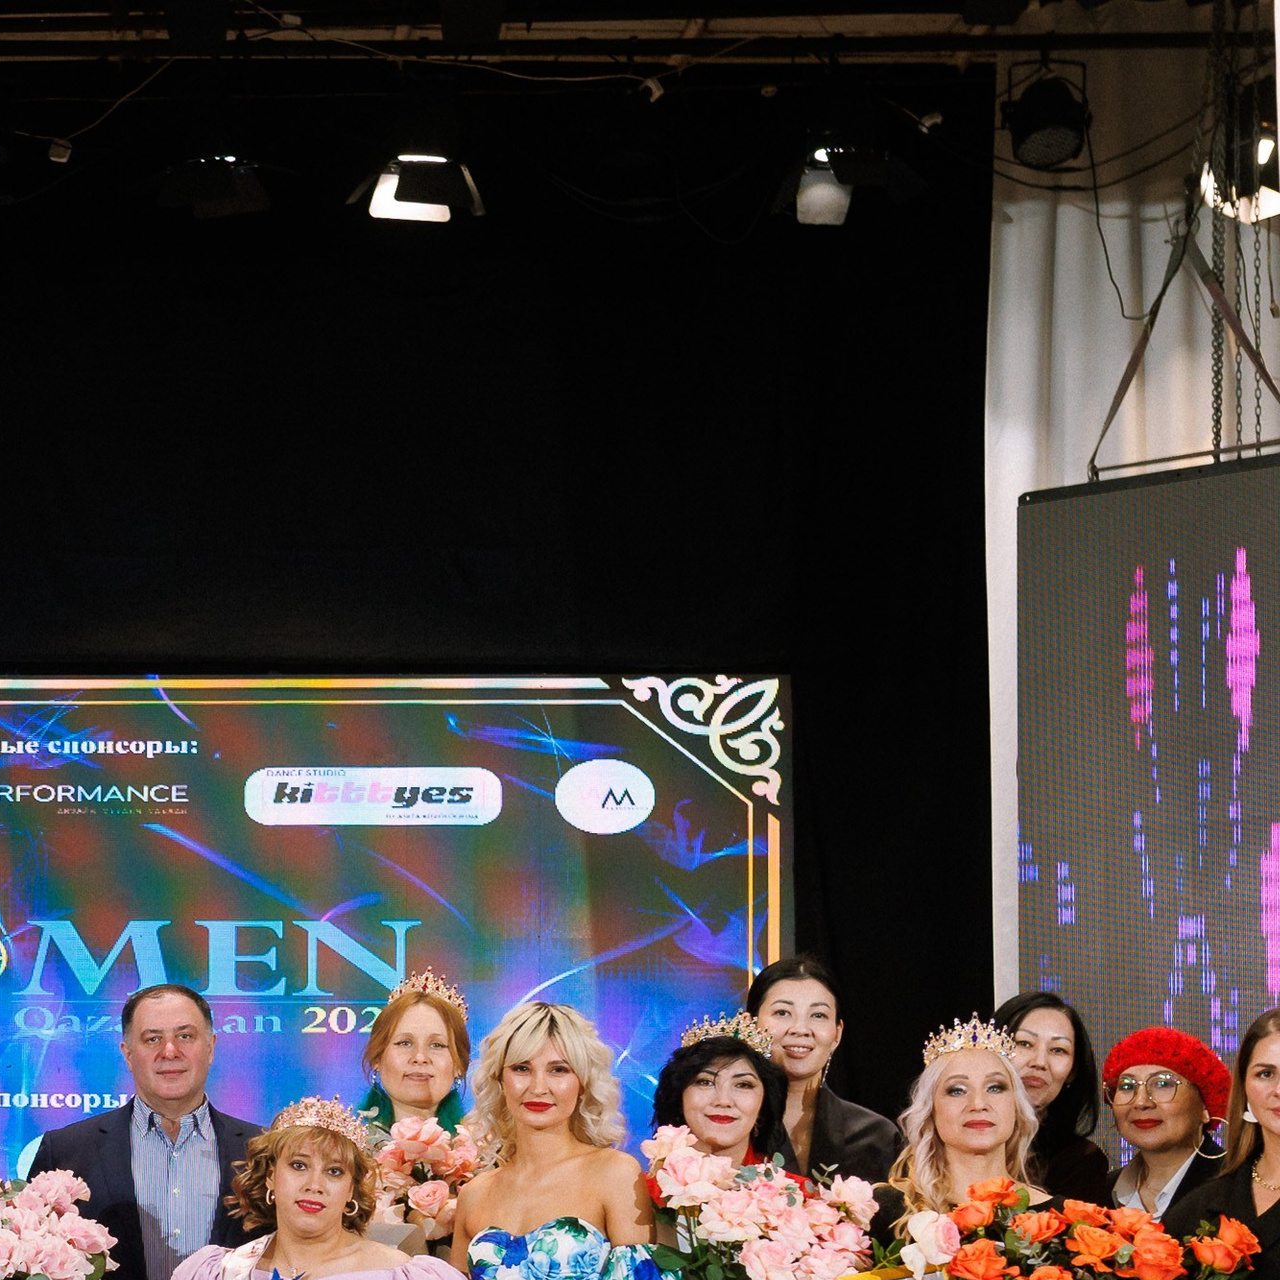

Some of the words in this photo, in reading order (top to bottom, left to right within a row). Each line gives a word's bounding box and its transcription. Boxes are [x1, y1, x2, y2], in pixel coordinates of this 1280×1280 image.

[48, 740, 198, 758] спонсоры:
[305, 769, 346, 777] STUDIO
[301, 1006, 383, 1034] 202
